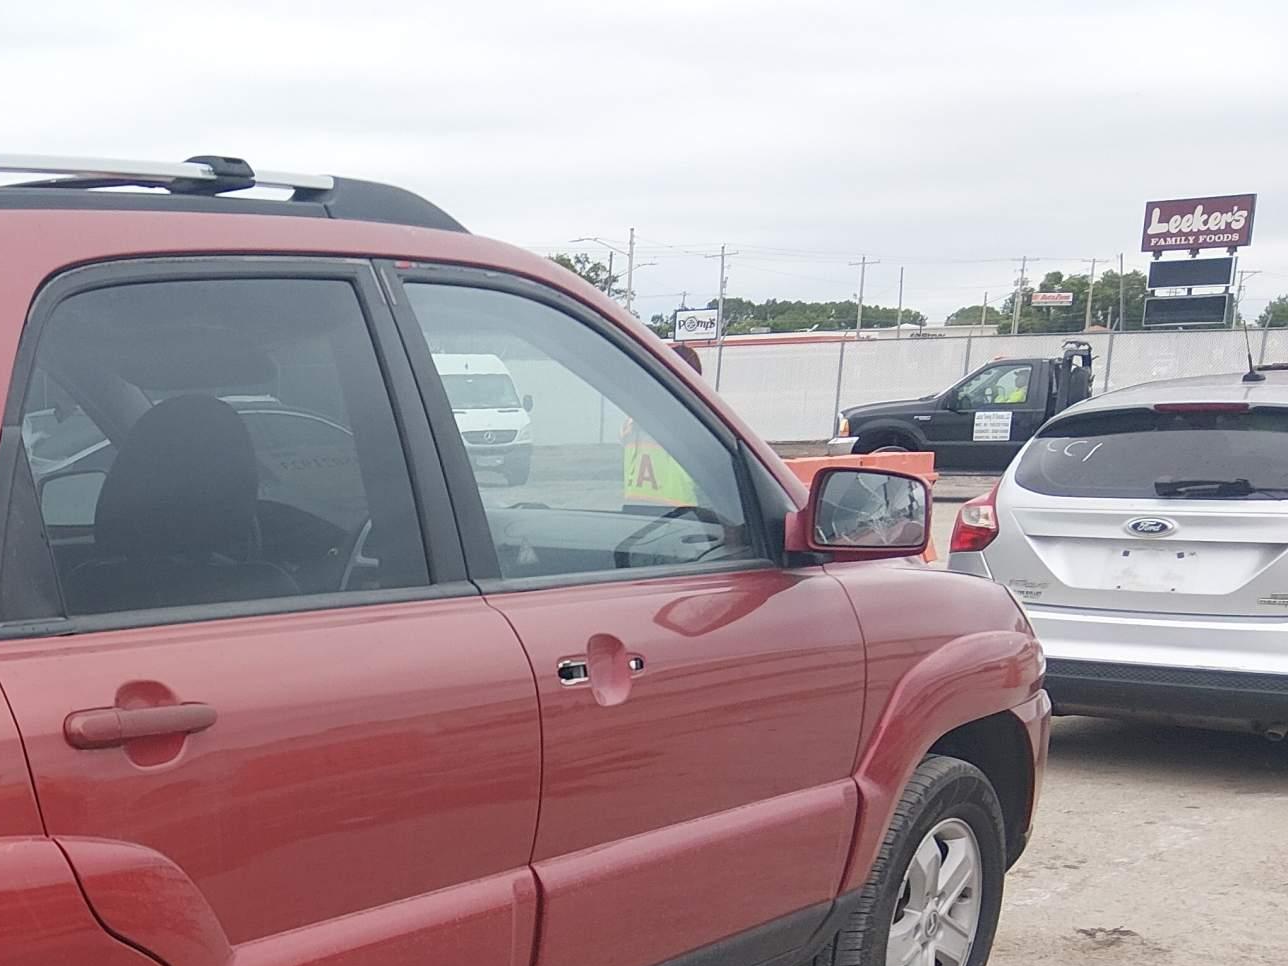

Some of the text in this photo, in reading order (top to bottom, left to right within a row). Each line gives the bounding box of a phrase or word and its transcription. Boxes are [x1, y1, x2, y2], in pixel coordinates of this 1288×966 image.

[1147, 205, 1248, 235] Leeker's
[1150, 233, 1239, 246] FAMILY FOODS
[1136, 520, 1163, 533] Ford
